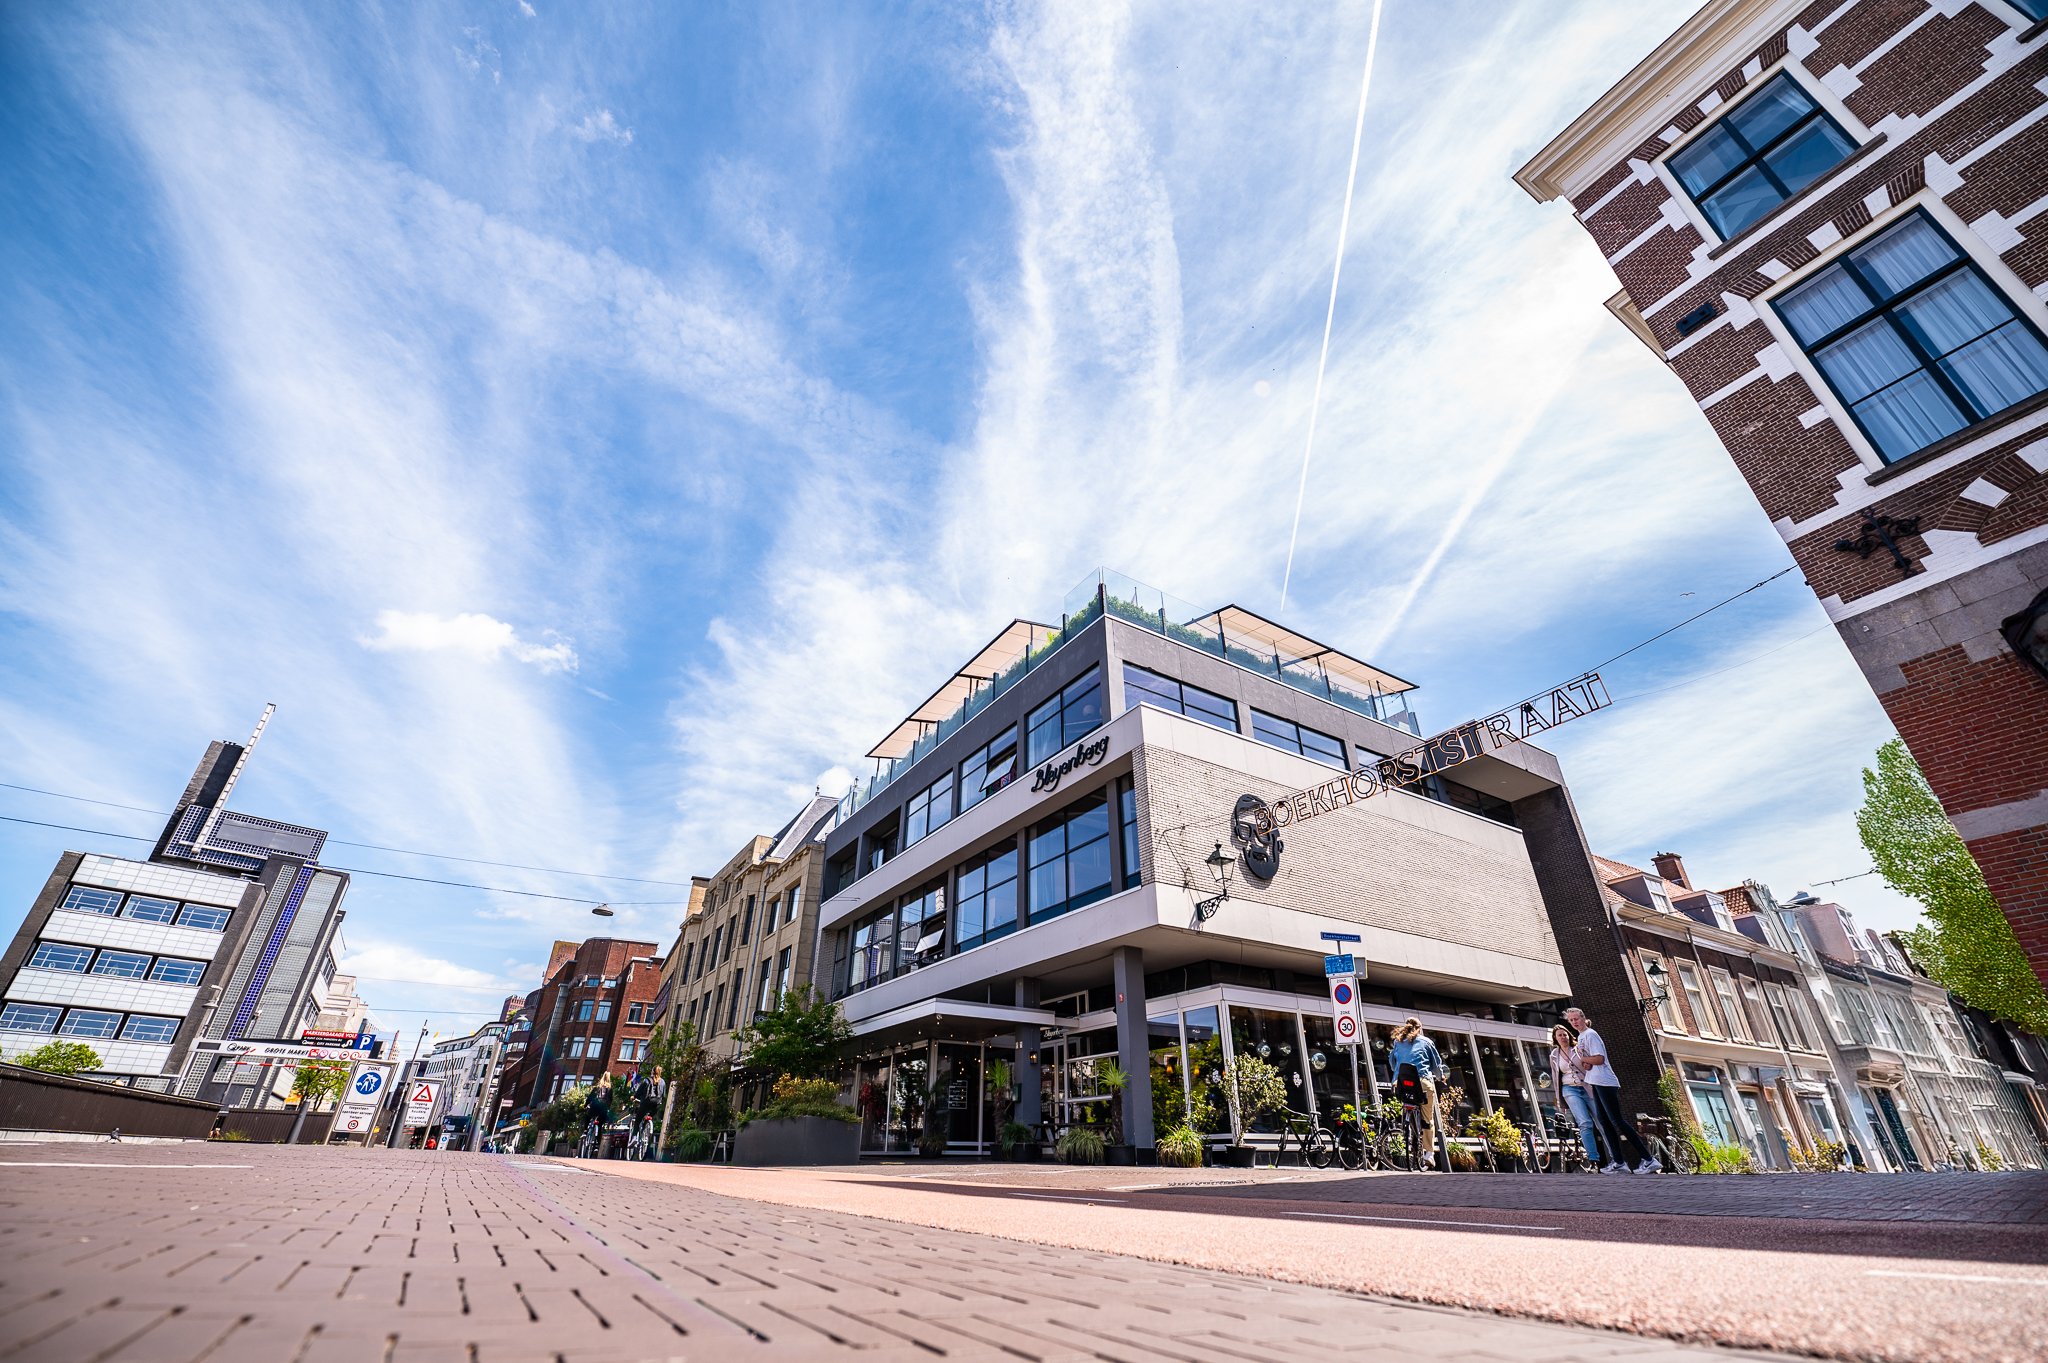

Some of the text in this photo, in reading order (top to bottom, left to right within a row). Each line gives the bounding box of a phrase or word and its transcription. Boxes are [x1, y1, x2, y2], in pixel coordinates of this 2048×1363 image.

[1254, 672, 1601, 835] BOEKHORSTSTRAAT
[1030, 735, 1110, 793] Bleyenberg
[1341, 1022, 1353, 1032] 30
[359, 1037, 371, 1049] P
[264, 1047, 286, 1055] GROTE
[287, 1048, 309, 1056] MARKT
